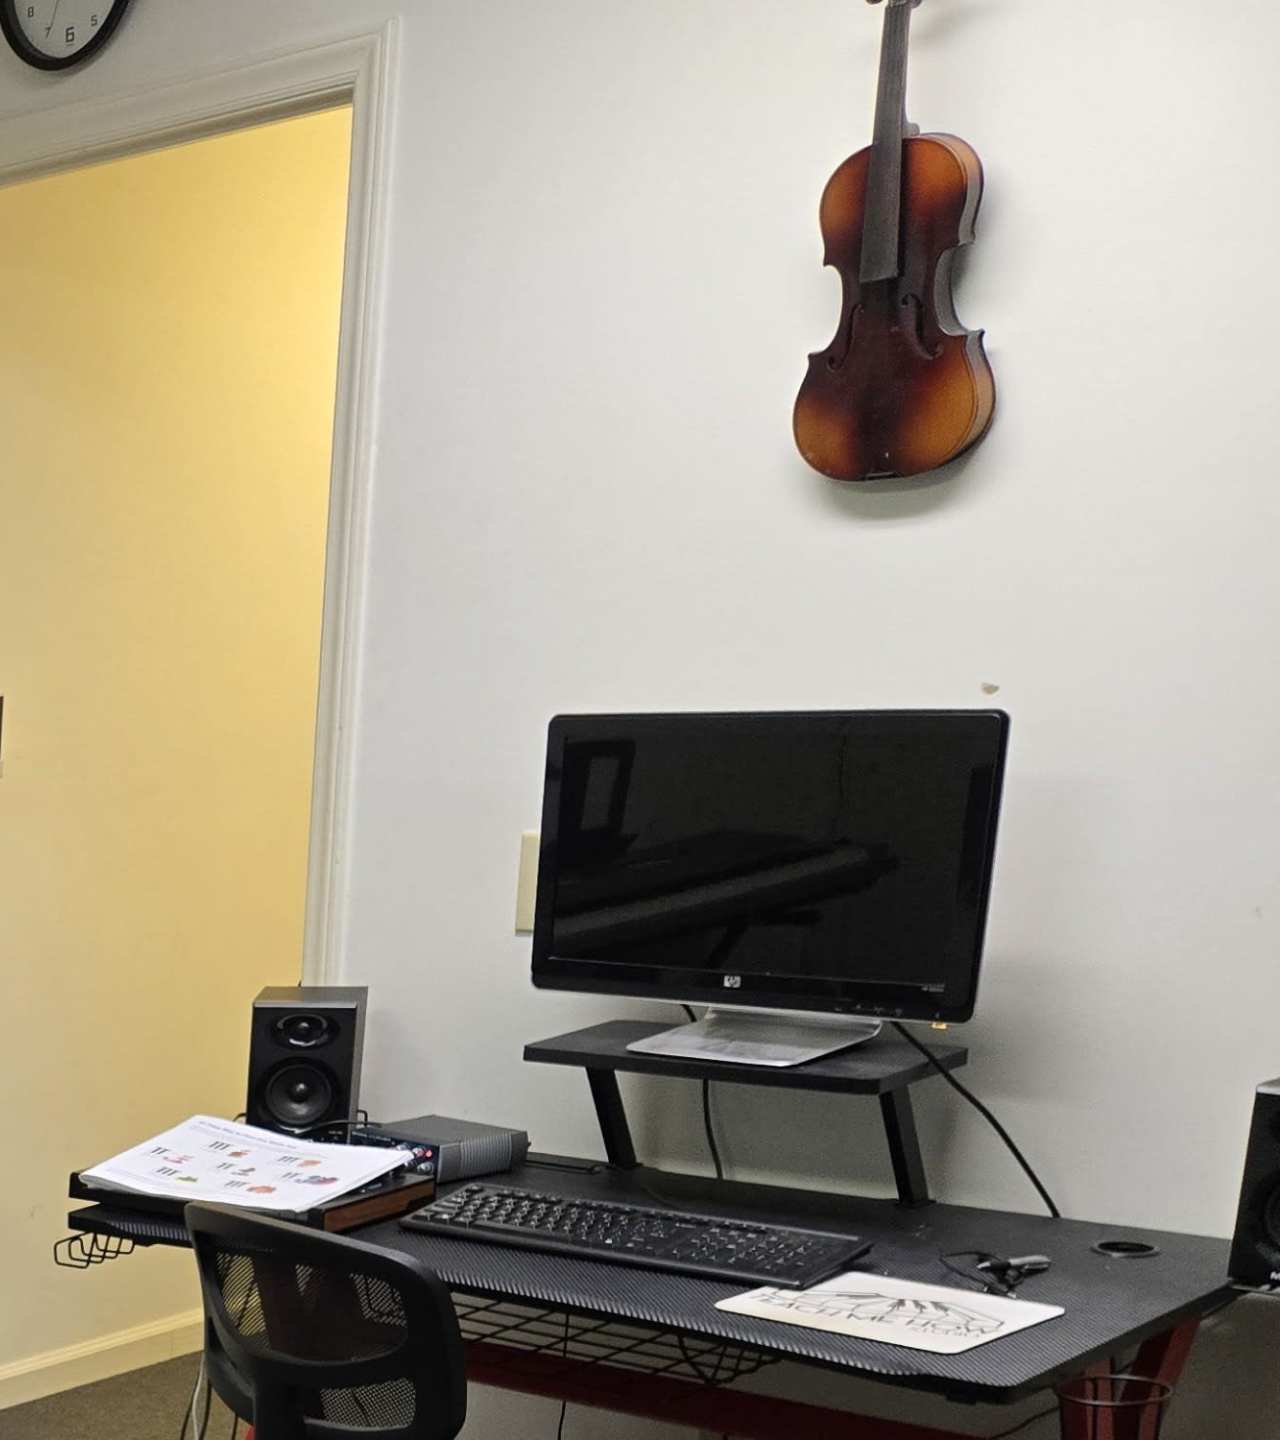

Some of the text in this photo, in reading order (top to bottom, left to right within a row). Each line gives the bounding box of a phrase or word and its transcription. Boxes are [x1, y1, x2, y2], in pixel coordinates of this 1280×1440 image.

[28, 6, 34, 17] 8
[91, 15, 98, 26] 5
[65, 26, 75, 43] 6
